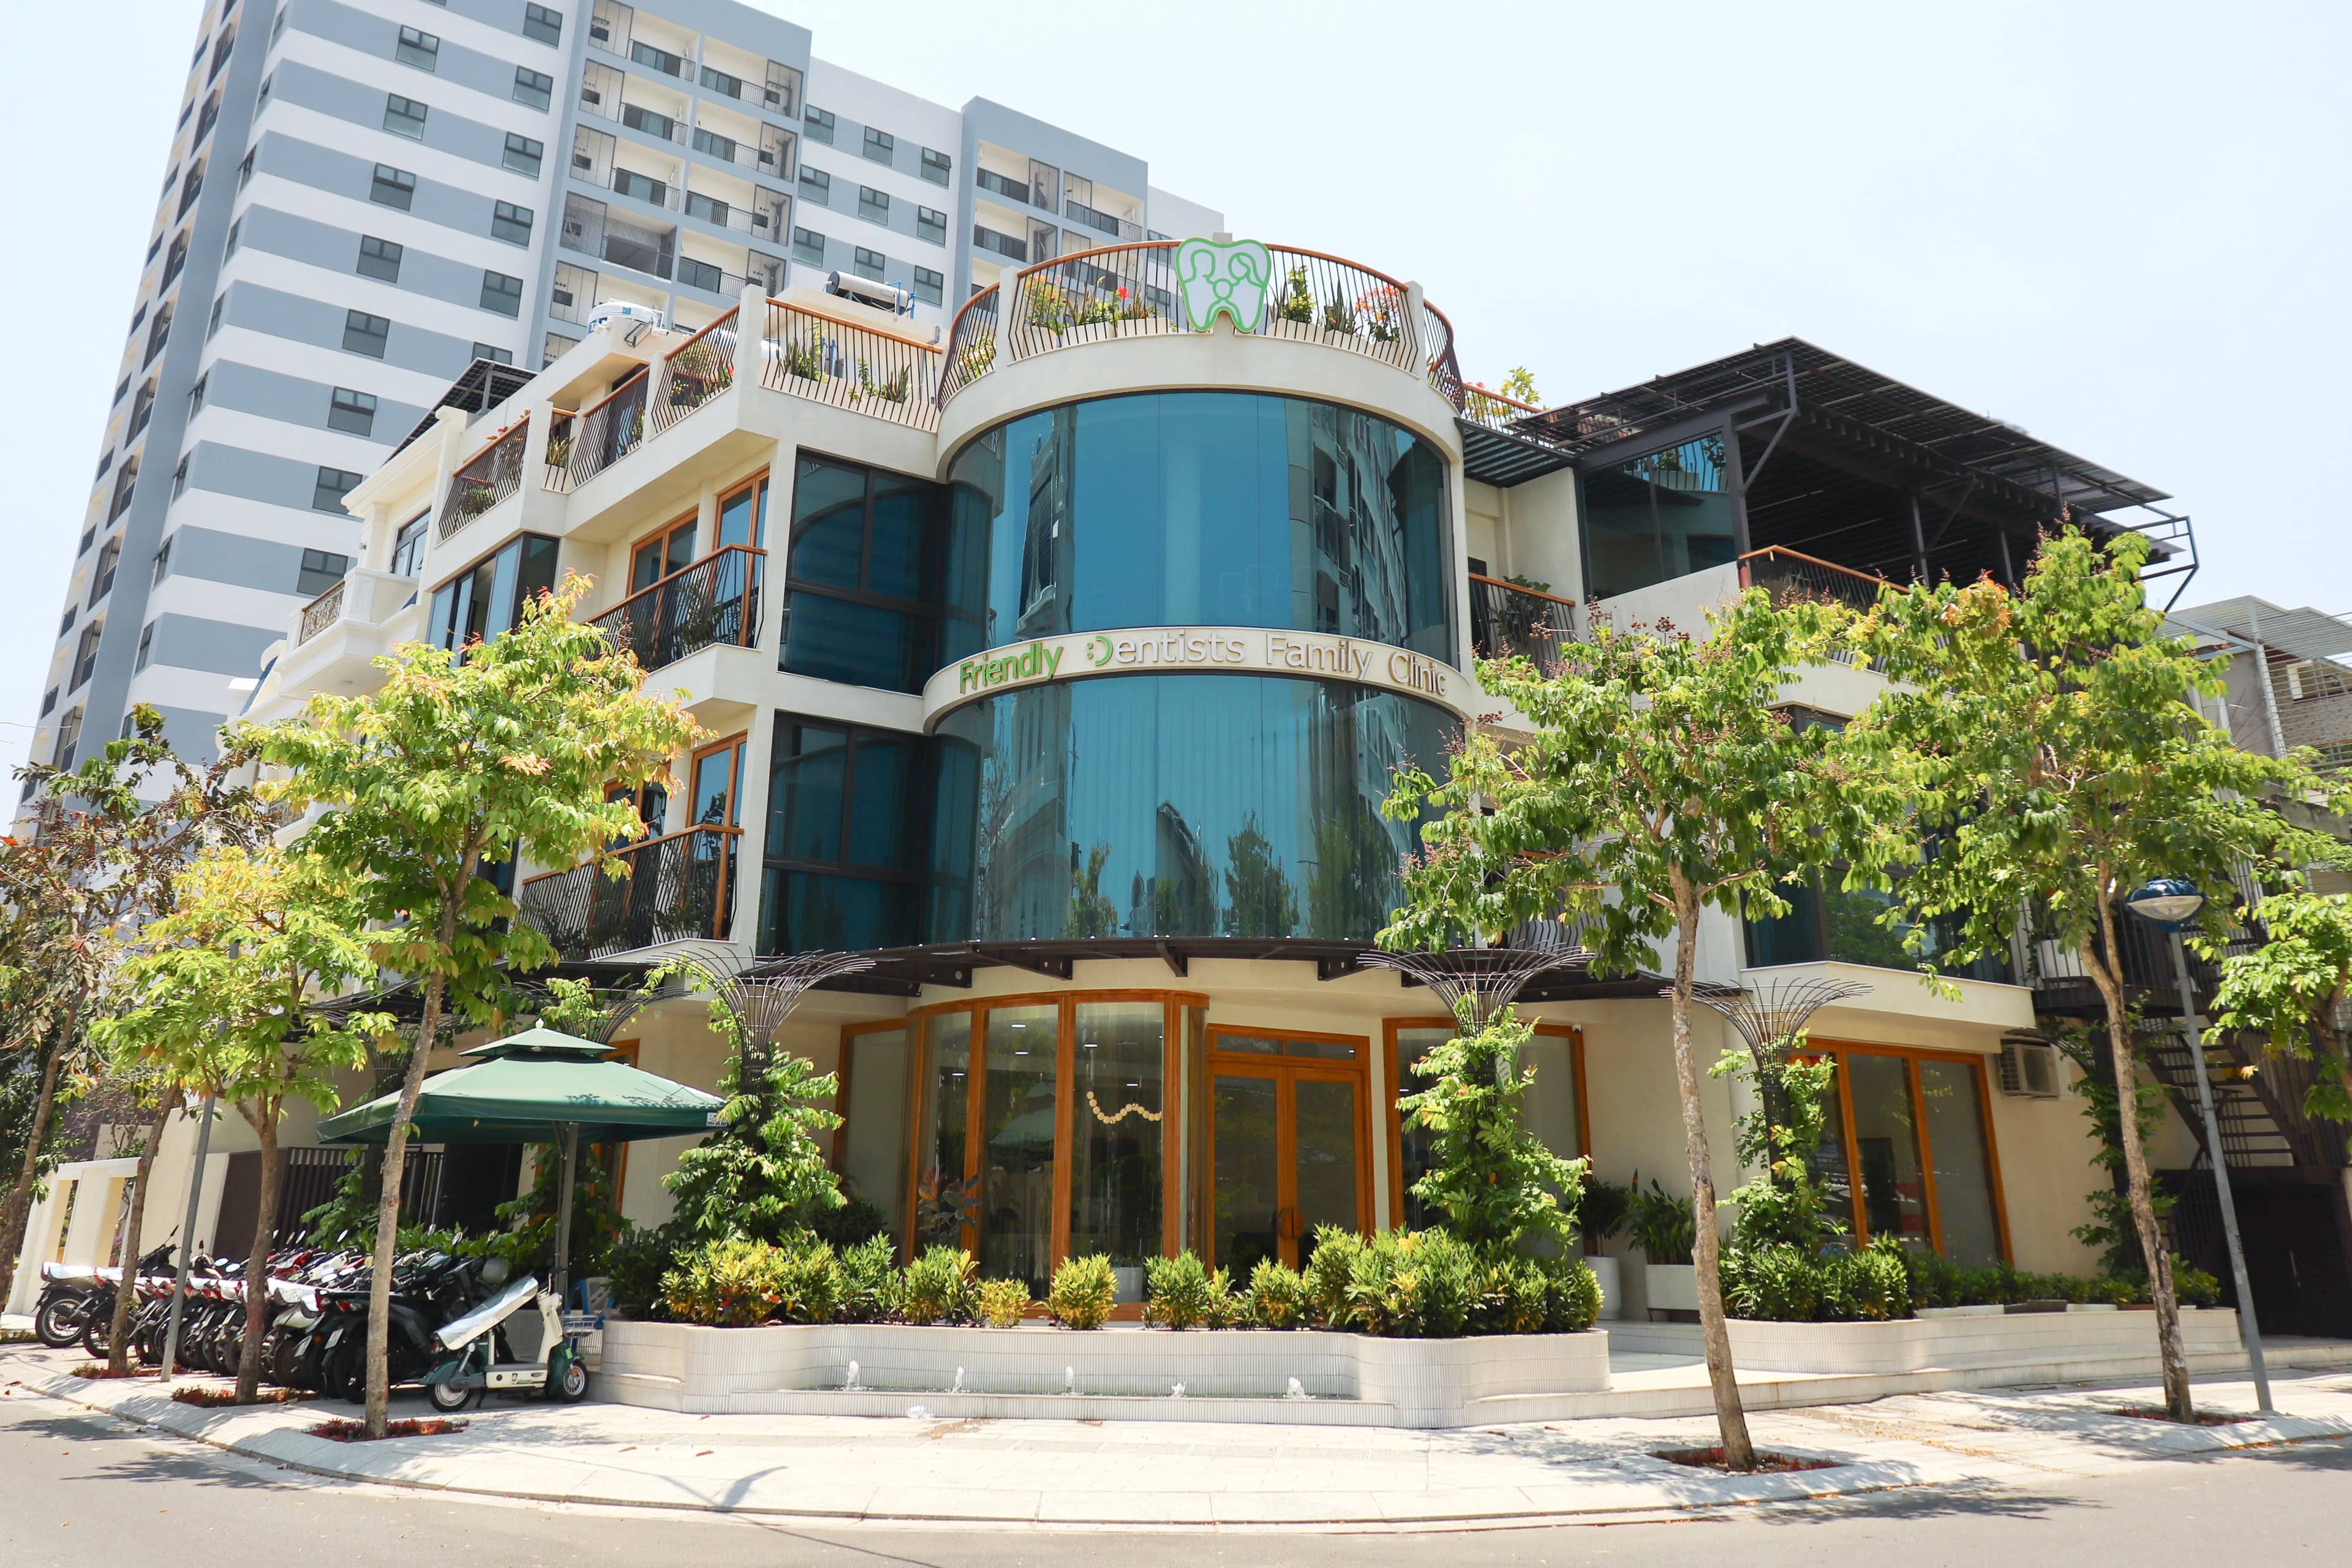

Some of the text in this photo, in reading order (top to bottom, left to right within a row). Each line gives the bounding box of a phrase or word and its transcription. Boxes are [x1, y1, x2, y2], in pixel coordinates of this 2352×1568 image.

[960, 642, 1063, 695] Friendly
[1267, 633, 1373, 680] Family
[1389, 651, 1447, 696] Clinic
